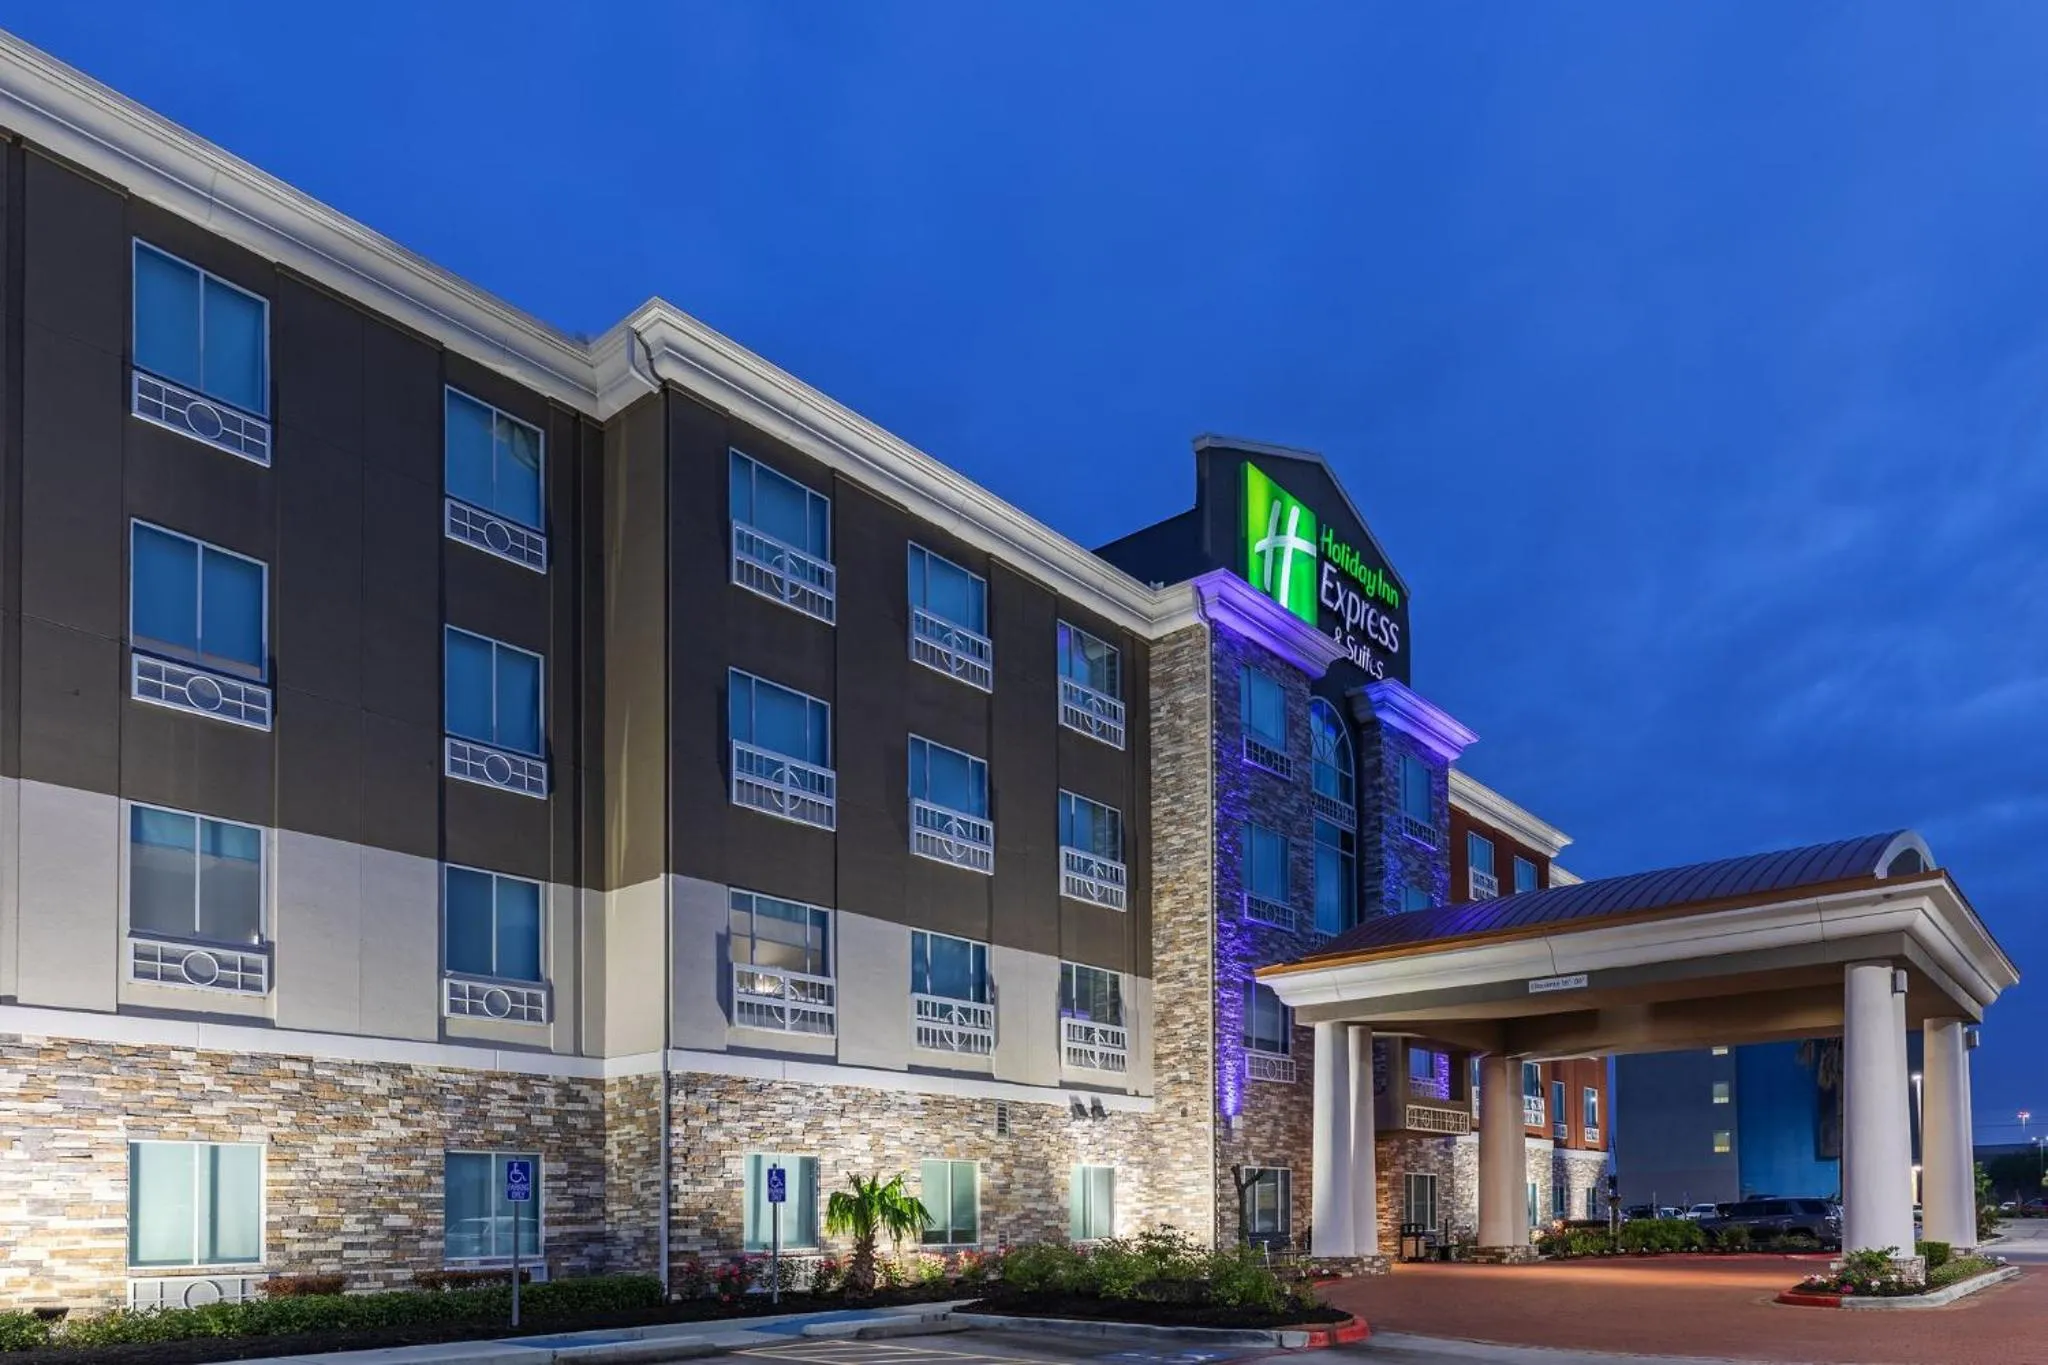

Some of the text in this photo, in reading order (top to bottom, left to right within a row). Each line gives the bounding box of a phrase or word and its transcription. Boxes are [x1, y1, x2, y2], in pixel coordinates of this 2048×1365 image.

[1320, 523, 1399, 610] Holiday Inn
[1333, 626, 1384, 680] & Suites
